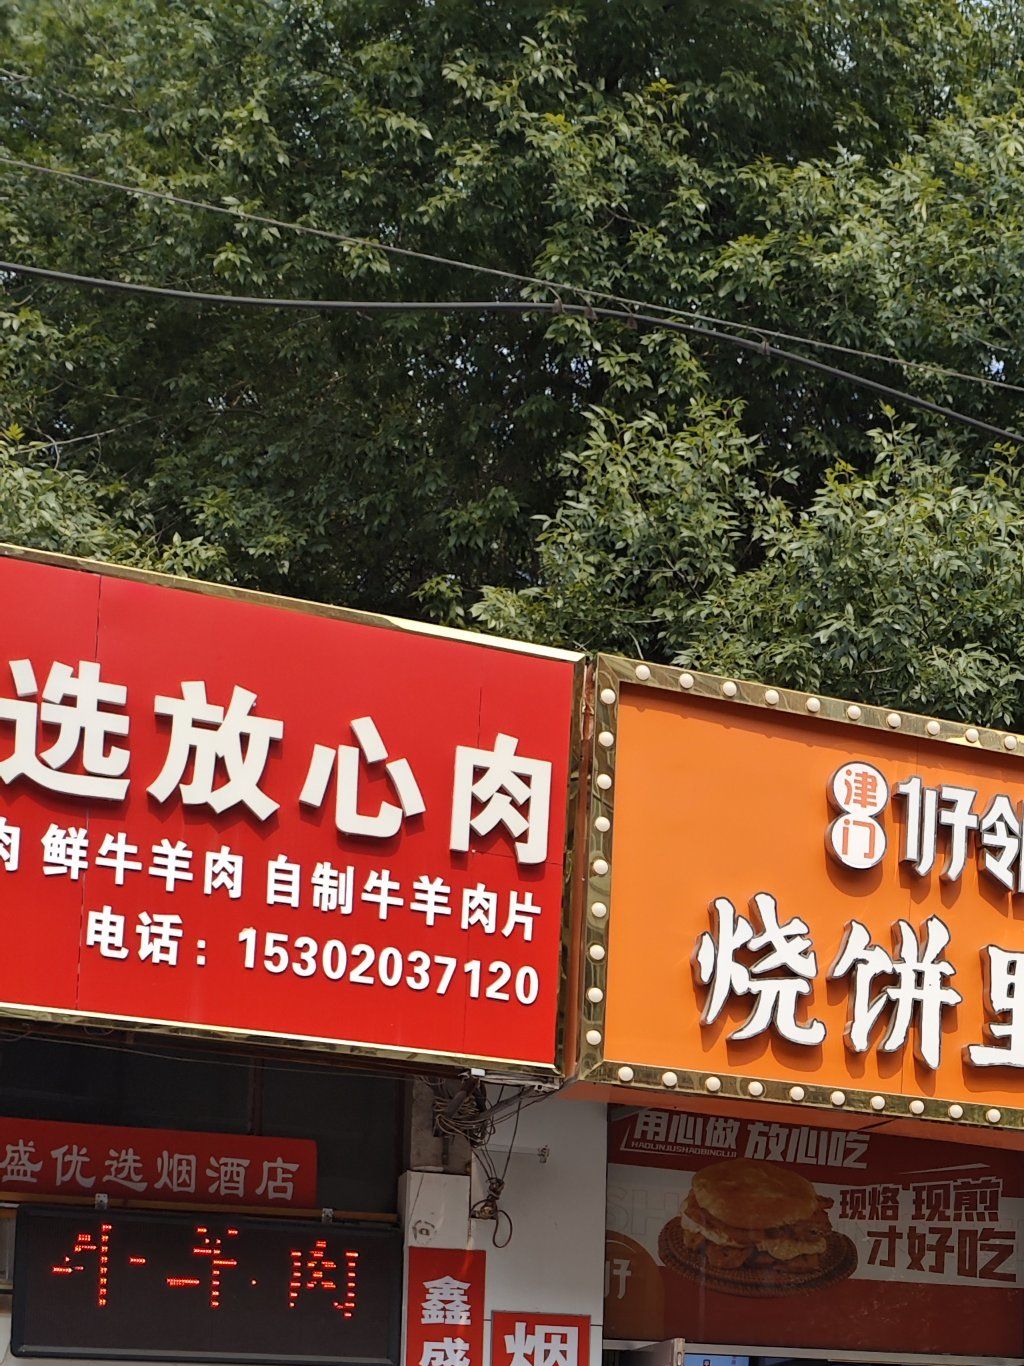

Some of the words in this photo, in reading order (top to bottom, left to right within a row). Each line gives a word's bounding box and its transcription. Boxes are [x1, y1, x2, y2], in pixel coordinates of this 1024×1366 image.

[0, 658, 552, 864] 选放心肉
[843, 768, 878, 859] 津门
[41, 823, 244, 899] 鲜牛羊肉
[266, 854, 542, 941] 自制牛羊肉片
[0, 1138, 300, 1201] 盛优选烟酒店
[633, 1110, 741, 1149] 用心做
[744, 1122, 871, 1169] 放心吃
[838, 1186, 900, 1222] 现烙
[911, 1179, 1001, 1222] 现煎
[866, 1224, 1017, 1283] 才好吃
